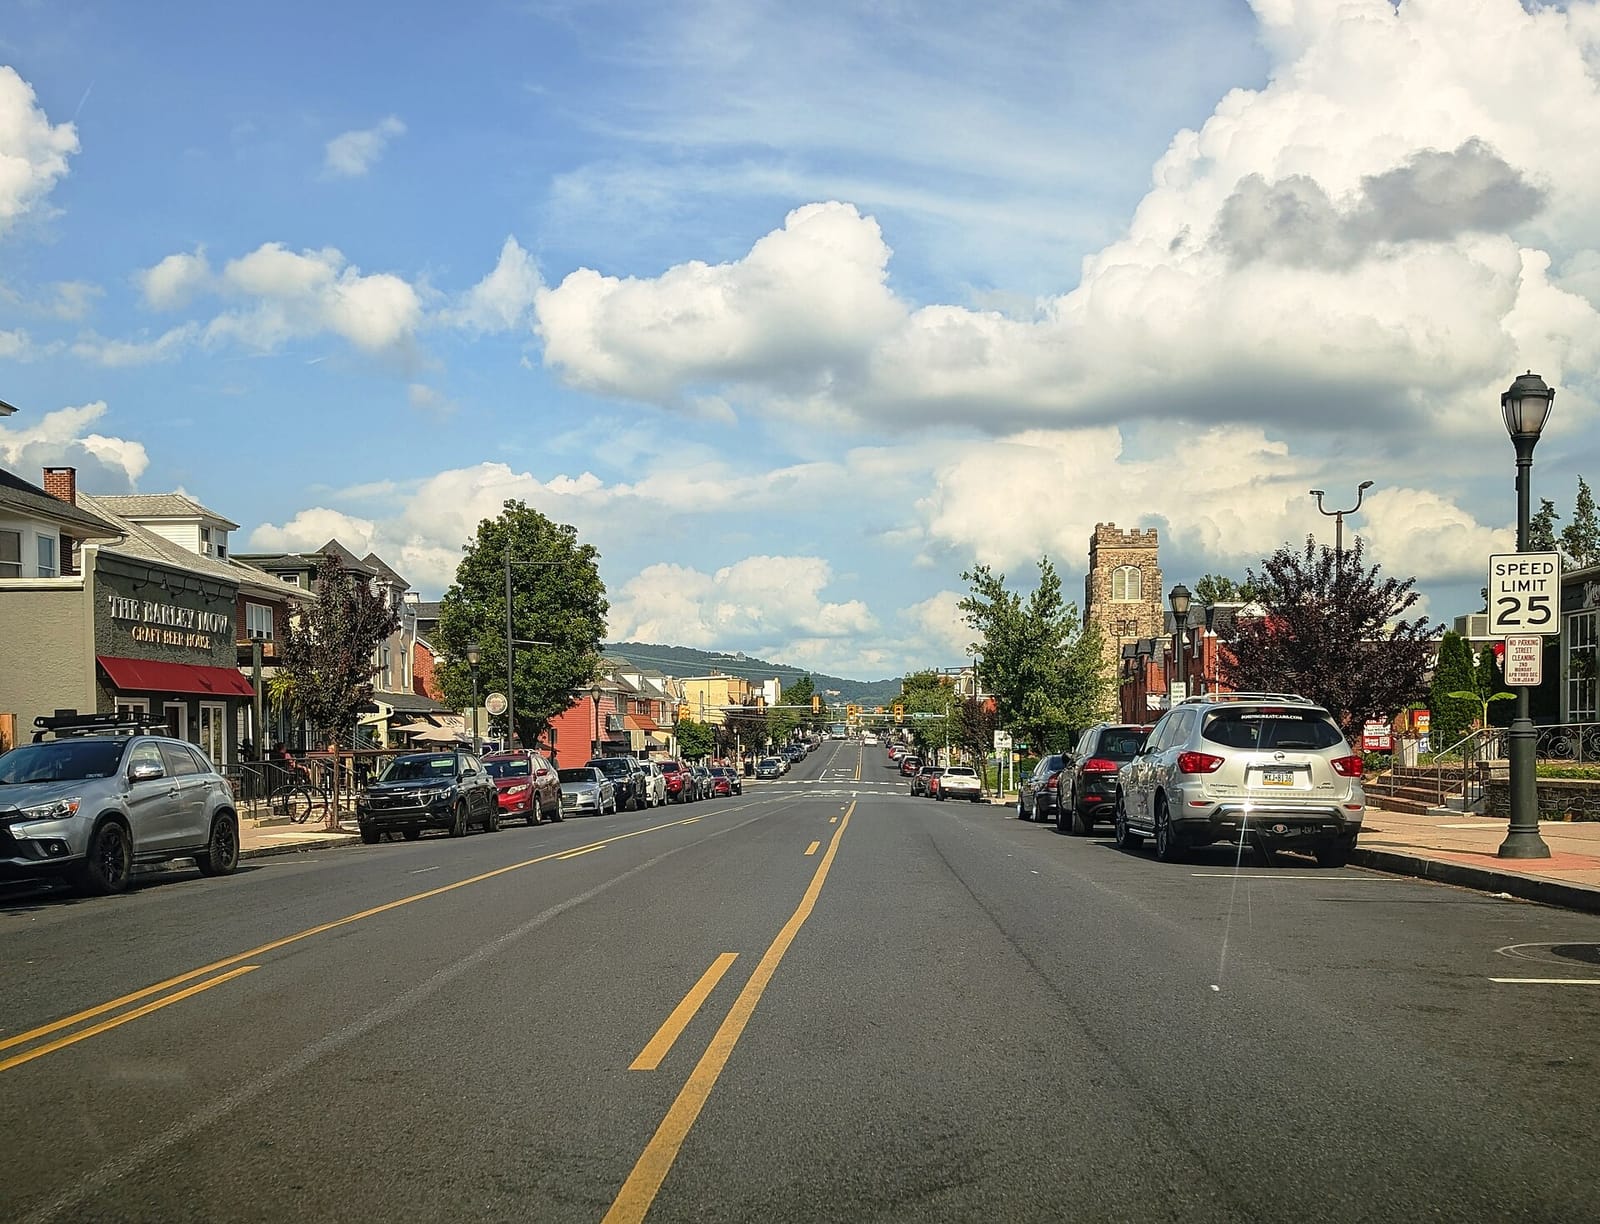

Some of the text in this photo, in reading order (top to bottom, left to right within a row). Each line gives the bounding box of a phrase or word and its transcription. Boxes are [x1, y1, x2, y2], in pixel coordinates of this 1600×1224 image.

[1495, 562, 1554, 576] SPEED
[1501, 579, 1547, 593] LIMIT
[108, 595, 228, 634] THE BARLEY MOW
[1496, 595, 1552, 626] 25
[132, 626, 211, 650] CRAFT BEER HOUSE
